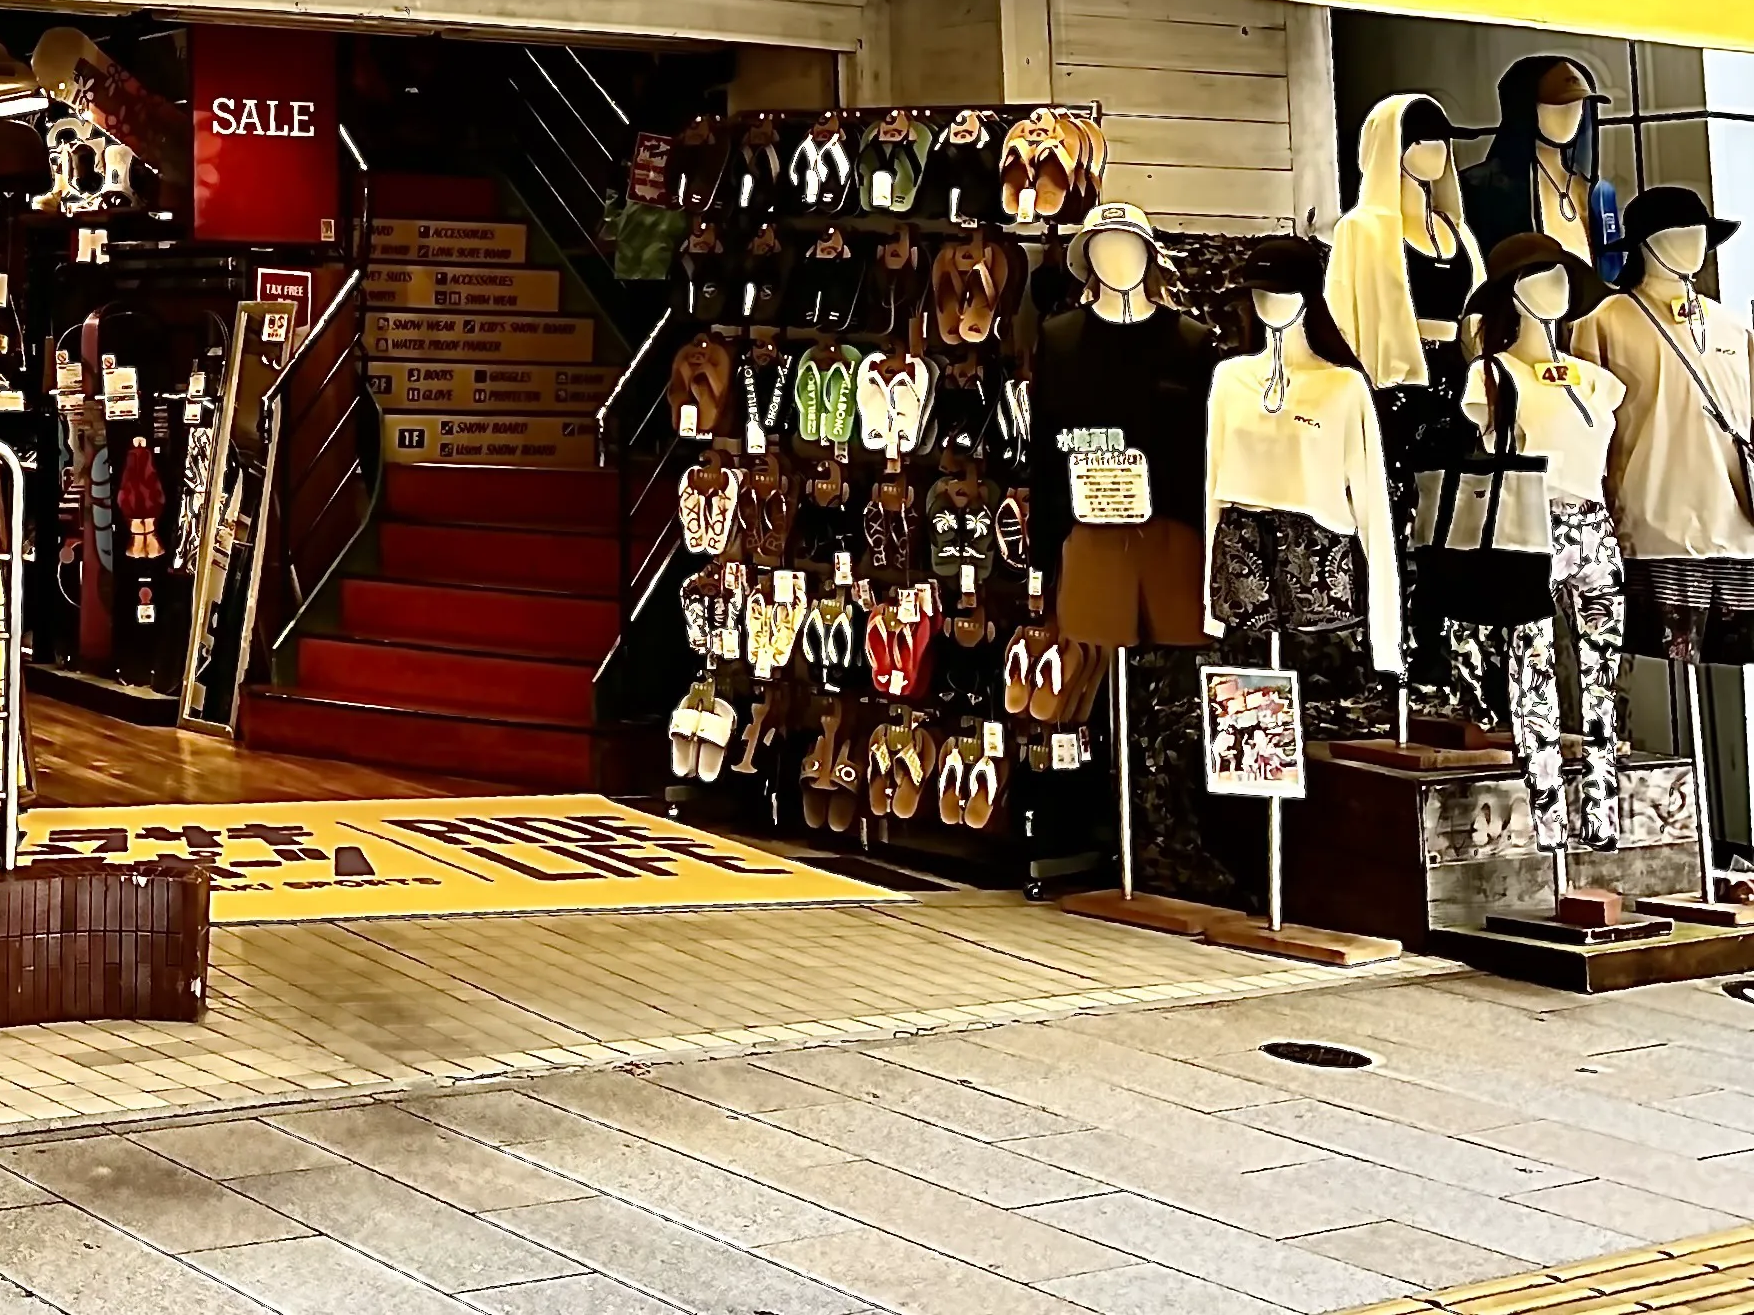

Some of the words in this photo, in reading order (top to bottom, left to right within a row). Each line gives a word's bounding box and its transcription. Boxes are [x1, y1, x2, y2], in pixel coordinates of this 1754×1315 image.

[212, 97, 316, 137] SALE
[265, 283, 282, 295] TAX
[283, 285, 304, 297] FREE
[392, 320, 423, 331] SNOW
[391, 339, 425, 351] WATER
[1541, 365, 1570, 383] 4F
[402, 431, 420, 446] 1F
[456, 422, 490, 434] SNOW
[492, 423, 528, 434] BOARD
[485, 444, 518, 456] SNOW
[680, 486, 703, 549] ROXY
[382, 815, 696, 844] RIDE
[460, 843, 794, 882] LIFE
